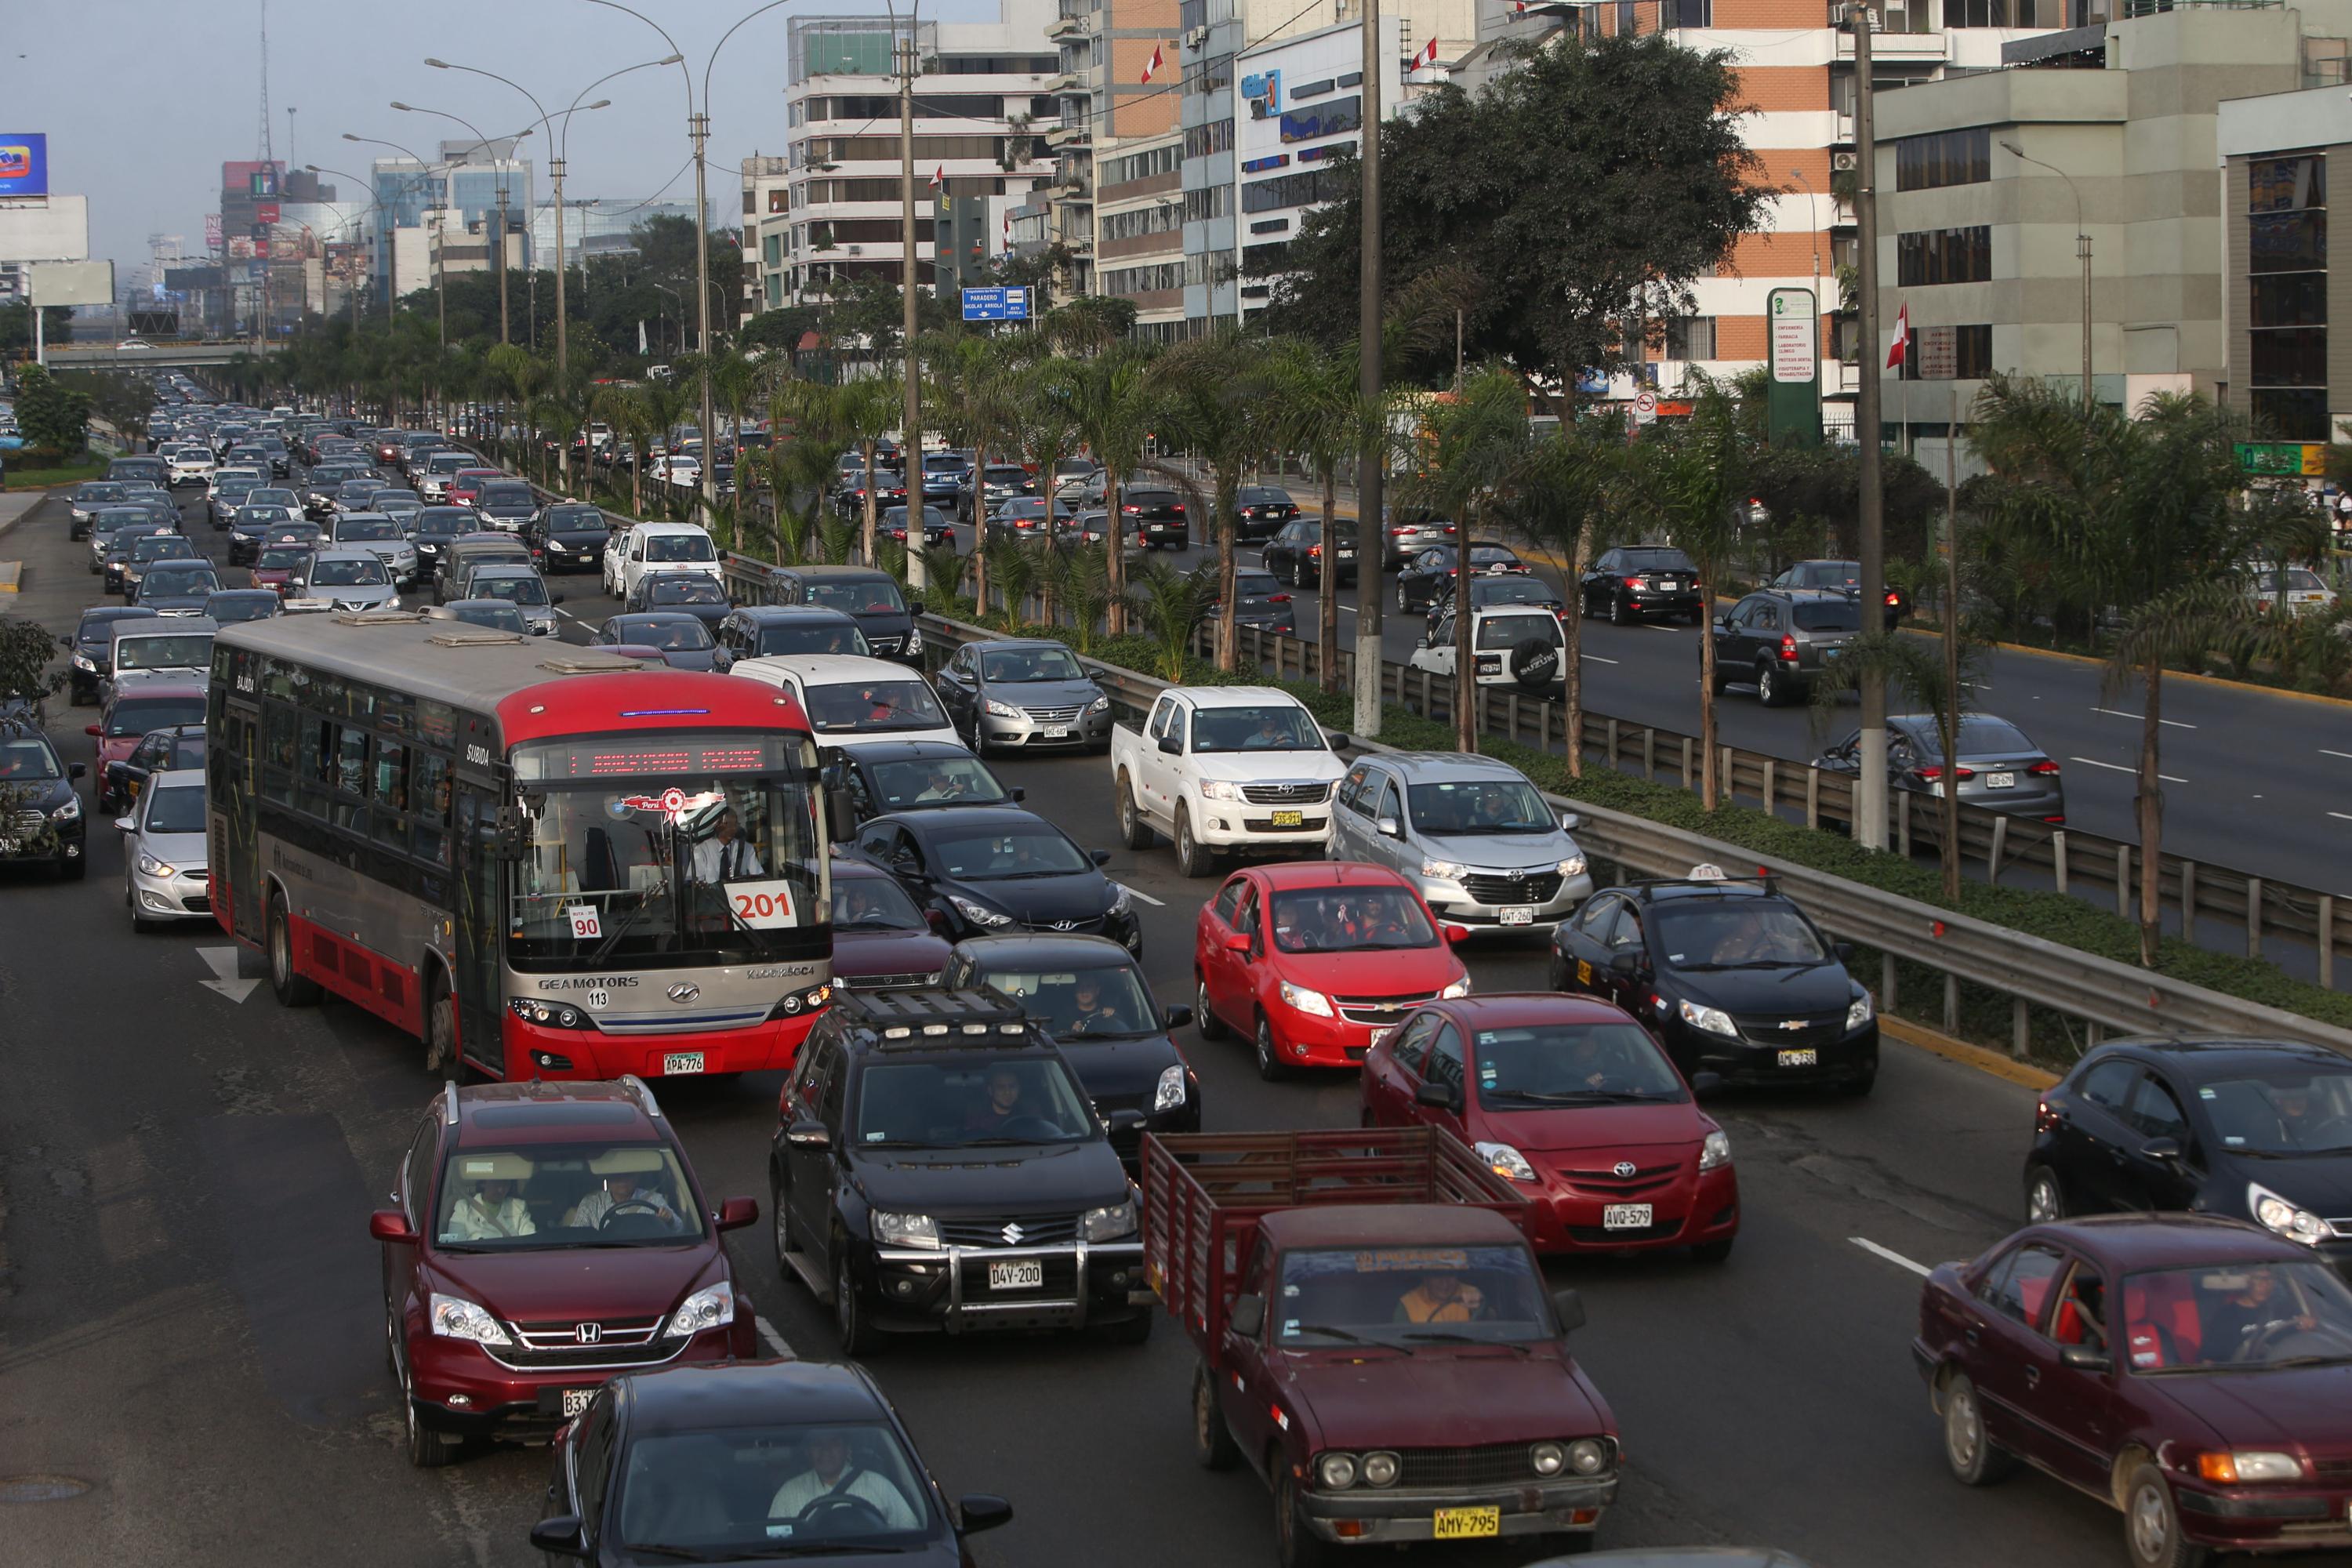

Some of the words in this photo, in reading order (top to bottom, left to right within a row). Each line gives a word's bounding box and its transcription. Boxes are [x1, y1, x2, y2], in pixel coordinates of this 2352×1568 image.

[1519, 652, 1558, 675] SUZUKI
[237, 674, 254, 694] BAJADA
[466, 742, 489, 767] SUBIDA
[735, 892, 789, 919] 201
[1501, 911, 1531, 922] AWT-260
[575, 918, 597, 935] 90
[538, 978, 571, 989] GEA
[573, 976, 639, 988] MOTORS
[589, 992, 607, 1005] 113
[666, 1058, 702, 1072] APA-776
[1606, 1210, 1650, 1225] AVQ-579
[992, 1266, 1040, 1285] D4Y-200
[1438, 1514, 1496, 1534] AMY-795
